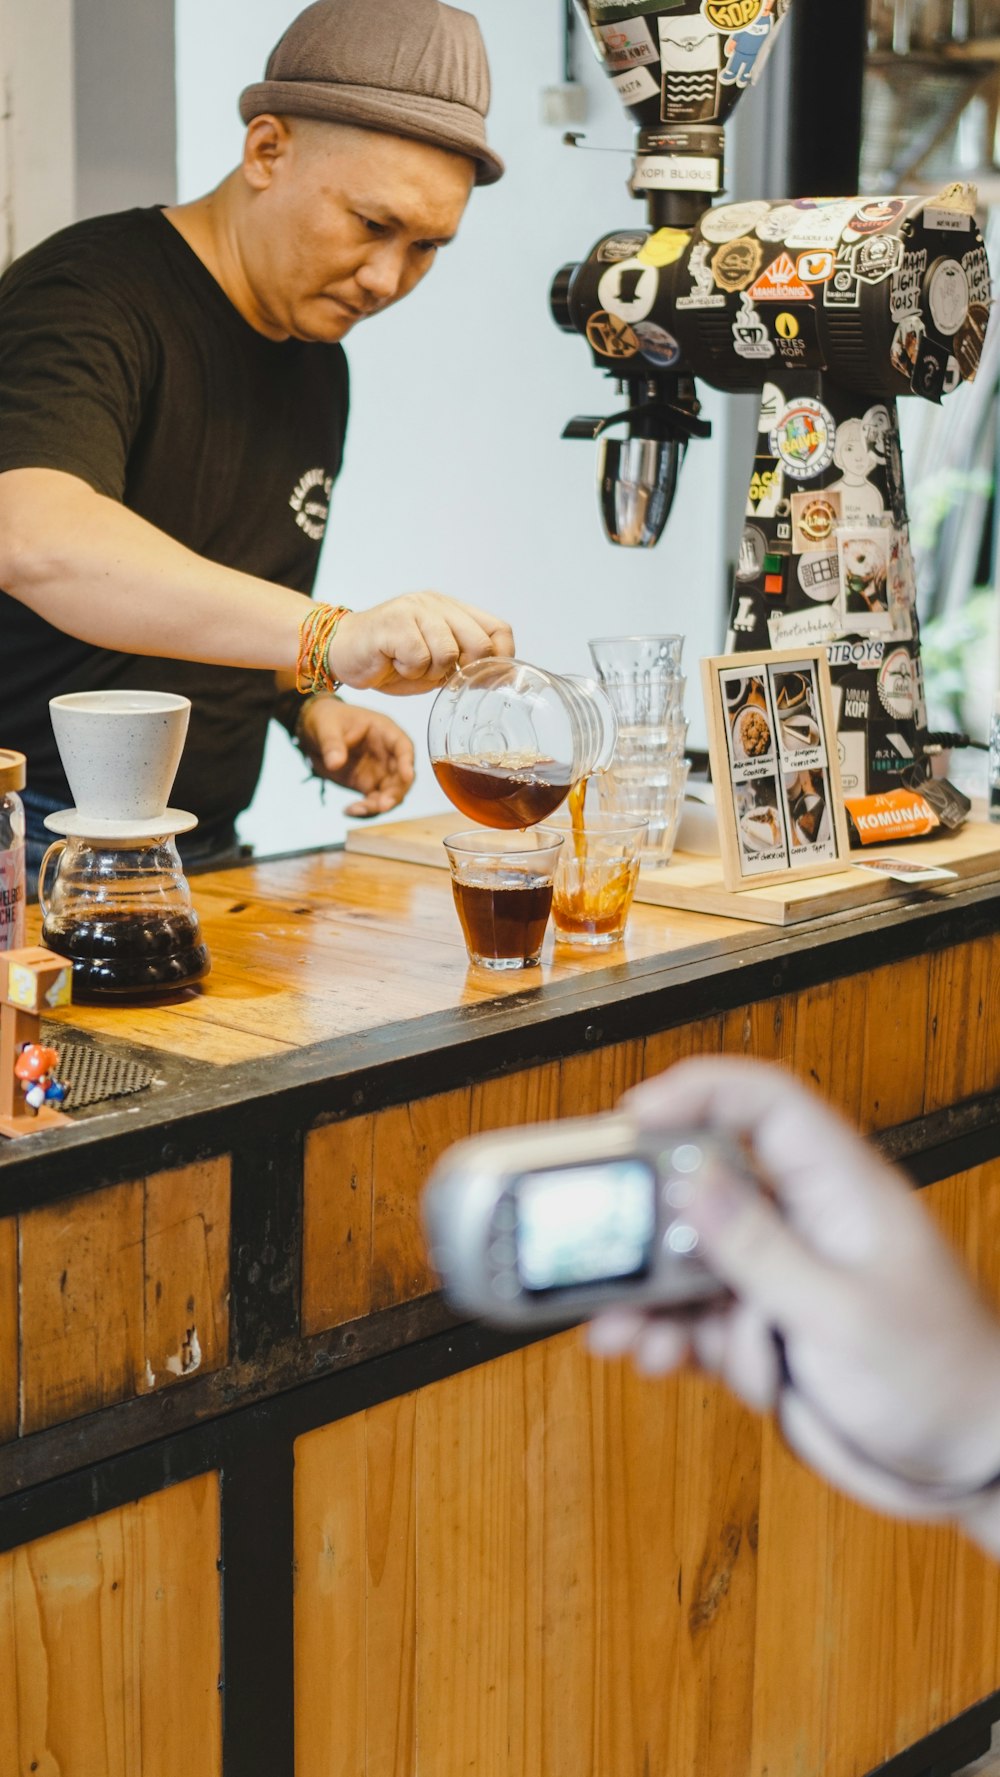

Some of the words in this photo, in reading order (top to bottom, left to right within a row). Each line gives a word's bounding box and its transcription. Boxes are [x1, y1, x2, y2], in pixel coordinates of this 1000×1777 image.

[641, 168, 665, 178] KOPI
[753, 286, 806, 298] MAHLKÖNIG
[774, 338, 806, 349] TETES
[780, 348, 804, 357] KOPI
[844, 701, 868, 718] KOPI
